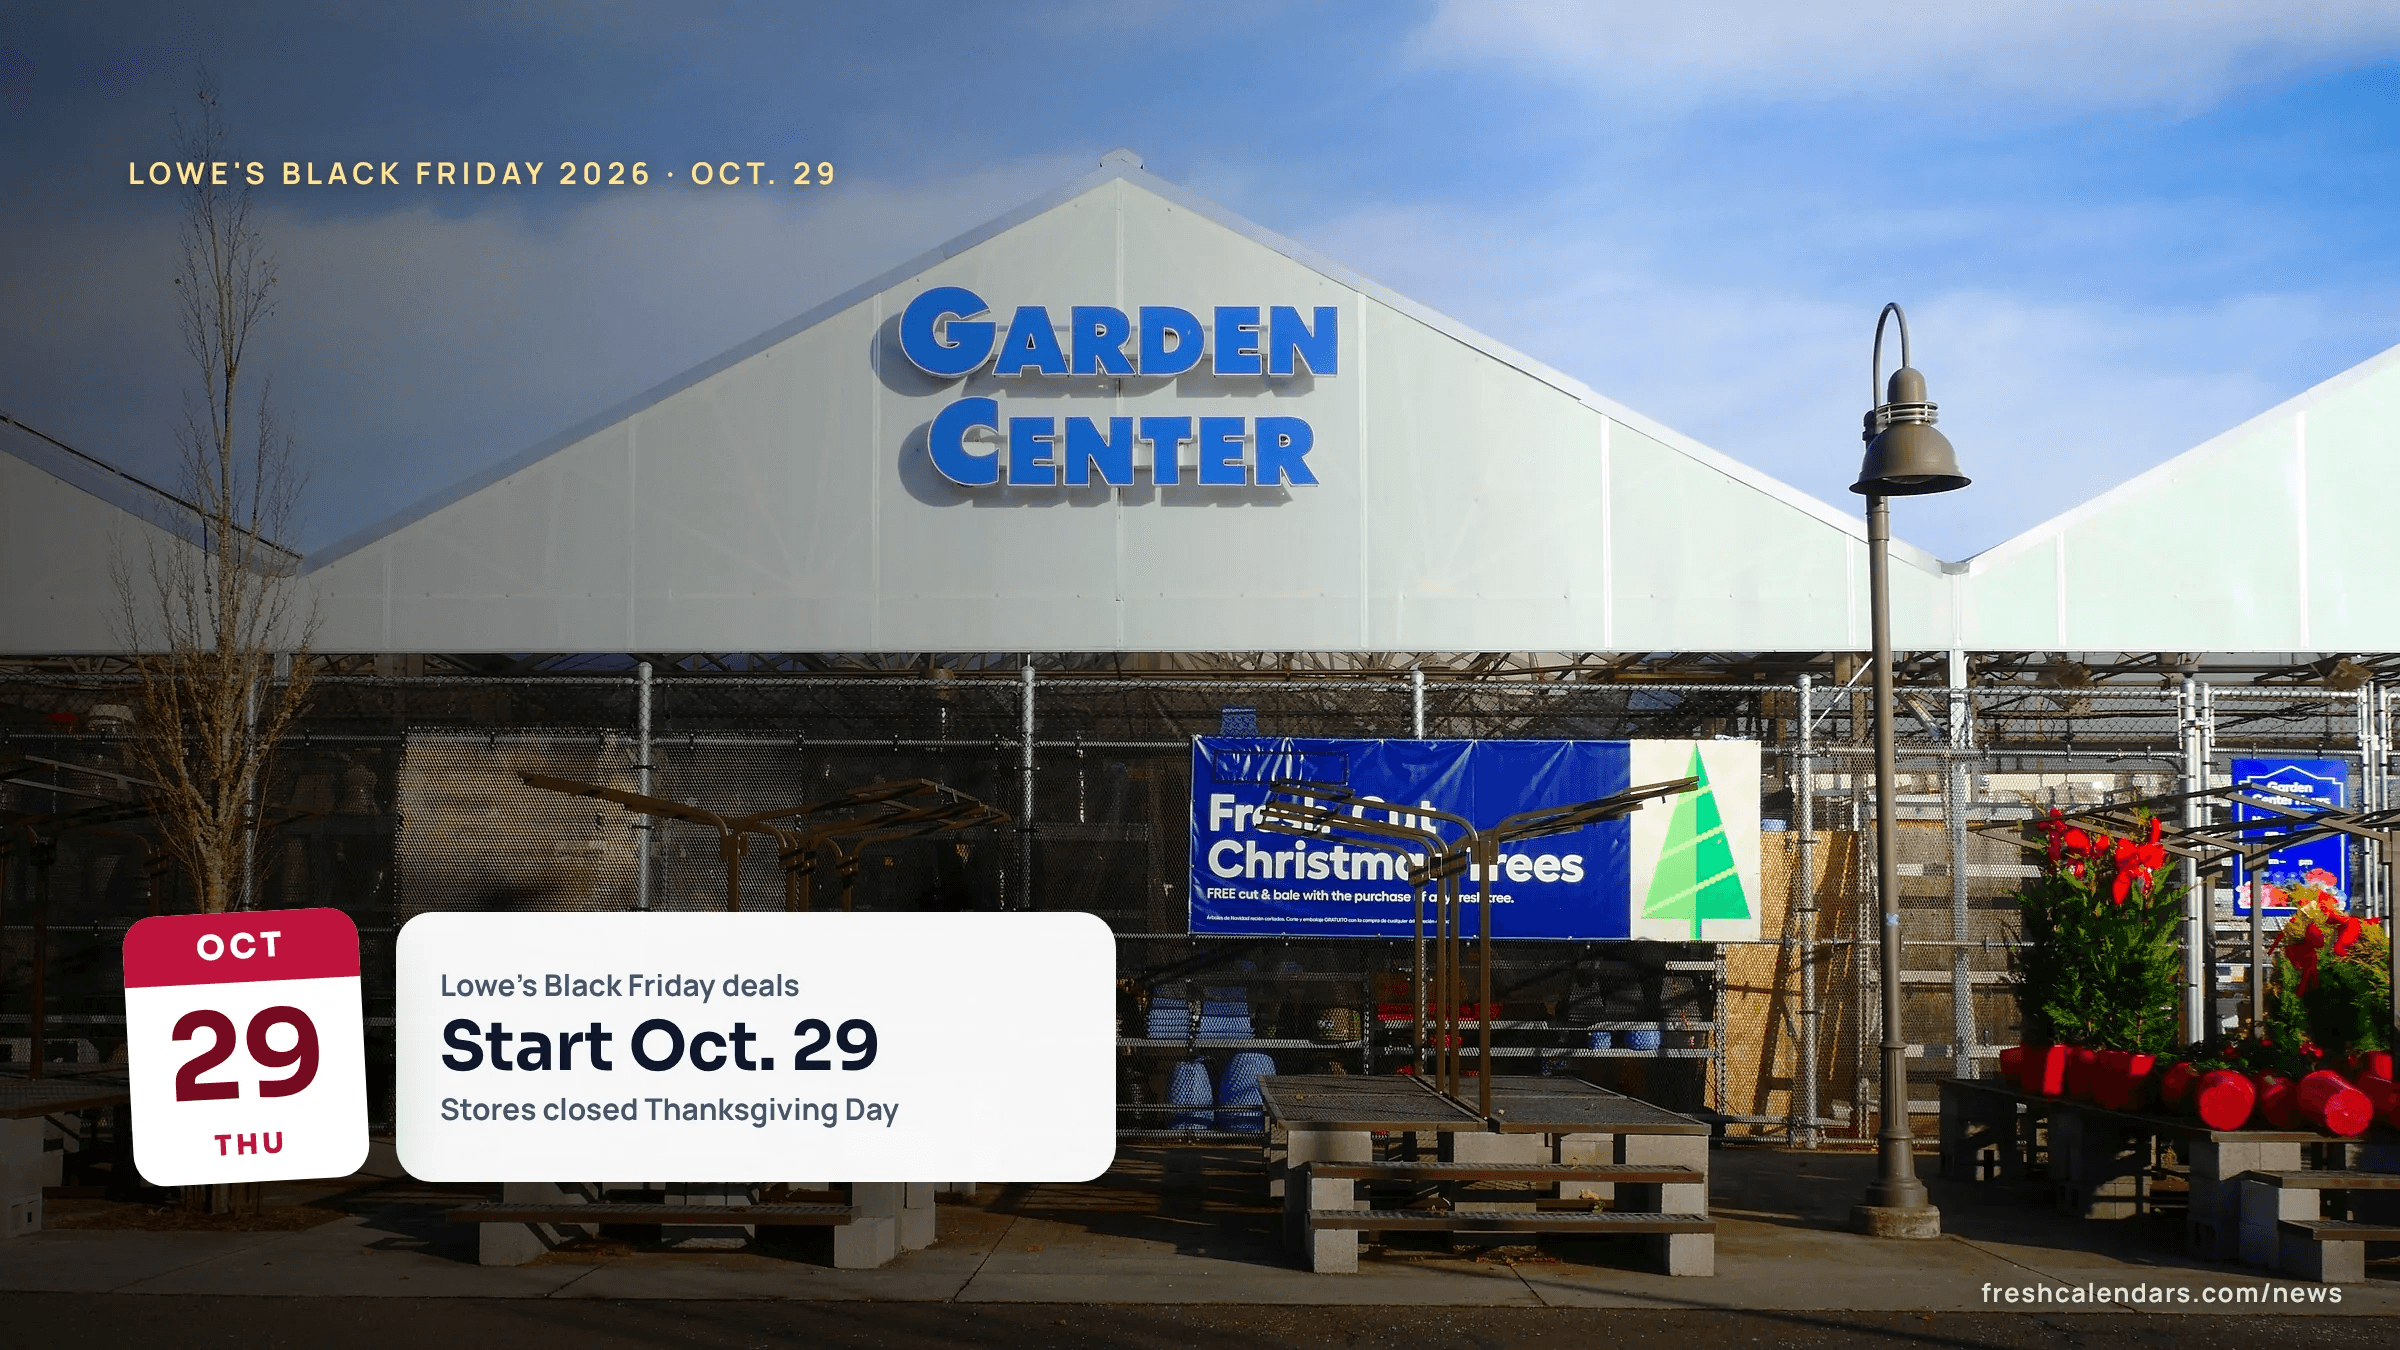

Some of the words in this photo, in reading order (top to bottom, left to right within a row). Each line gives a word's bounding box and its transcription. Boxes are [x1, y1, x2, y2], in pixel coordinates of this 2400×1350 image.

[898, 286, 1339, 378] GARDEN
[927, 396, 1320, 488] CENTER
[1208, 840, 1443, 881] Christma
[1207, 888, 1236, 899] FREE
[1238, 889, 1259, 900] cut
[1261, 888, 1271, 900] &
[1273, 889, 1300, 901] bale
[1302, 889, 1329, 901] with
[1331, 889, 1352, 902] the
[1354, 890, 1411, 904] purchase
[1428, 893, 1451, 905] ay
